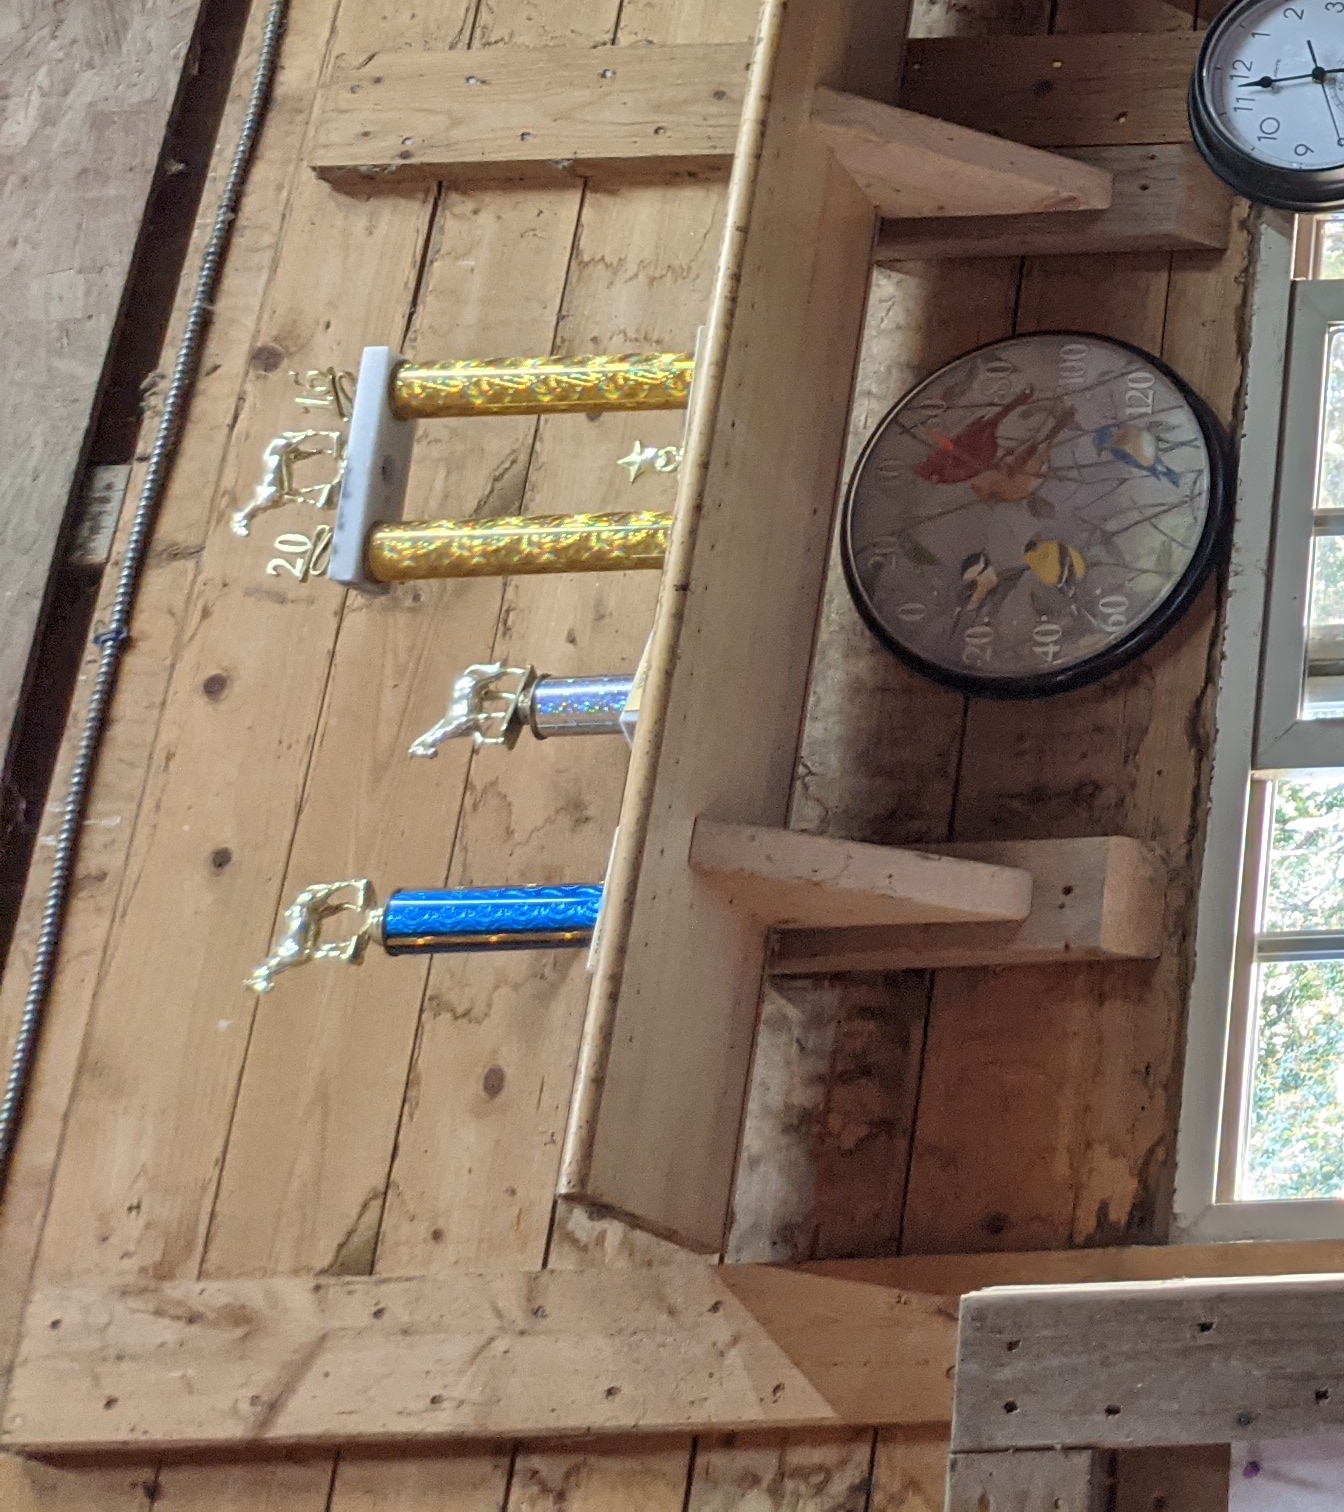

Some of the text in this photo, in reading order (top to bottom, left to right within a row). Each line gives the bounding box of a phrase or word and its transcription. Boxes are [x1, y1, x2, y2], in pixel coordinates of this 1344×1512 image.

[1283, 7, 1304, 20] 2
[1324, 1, 1344, 14] 3
[1229, 59, 1253, 81] 12
[1233, 97, 1256, 113] 11
[1257, 117, 1280, 142] 10
[1294, 143, 1314, 157] 9
[1057, 343, 1089, 386] 100
[1124, 370, 1155, 415] 120
[266, 533, 312, 576] 20
[898, 603, 927, 622] 0
